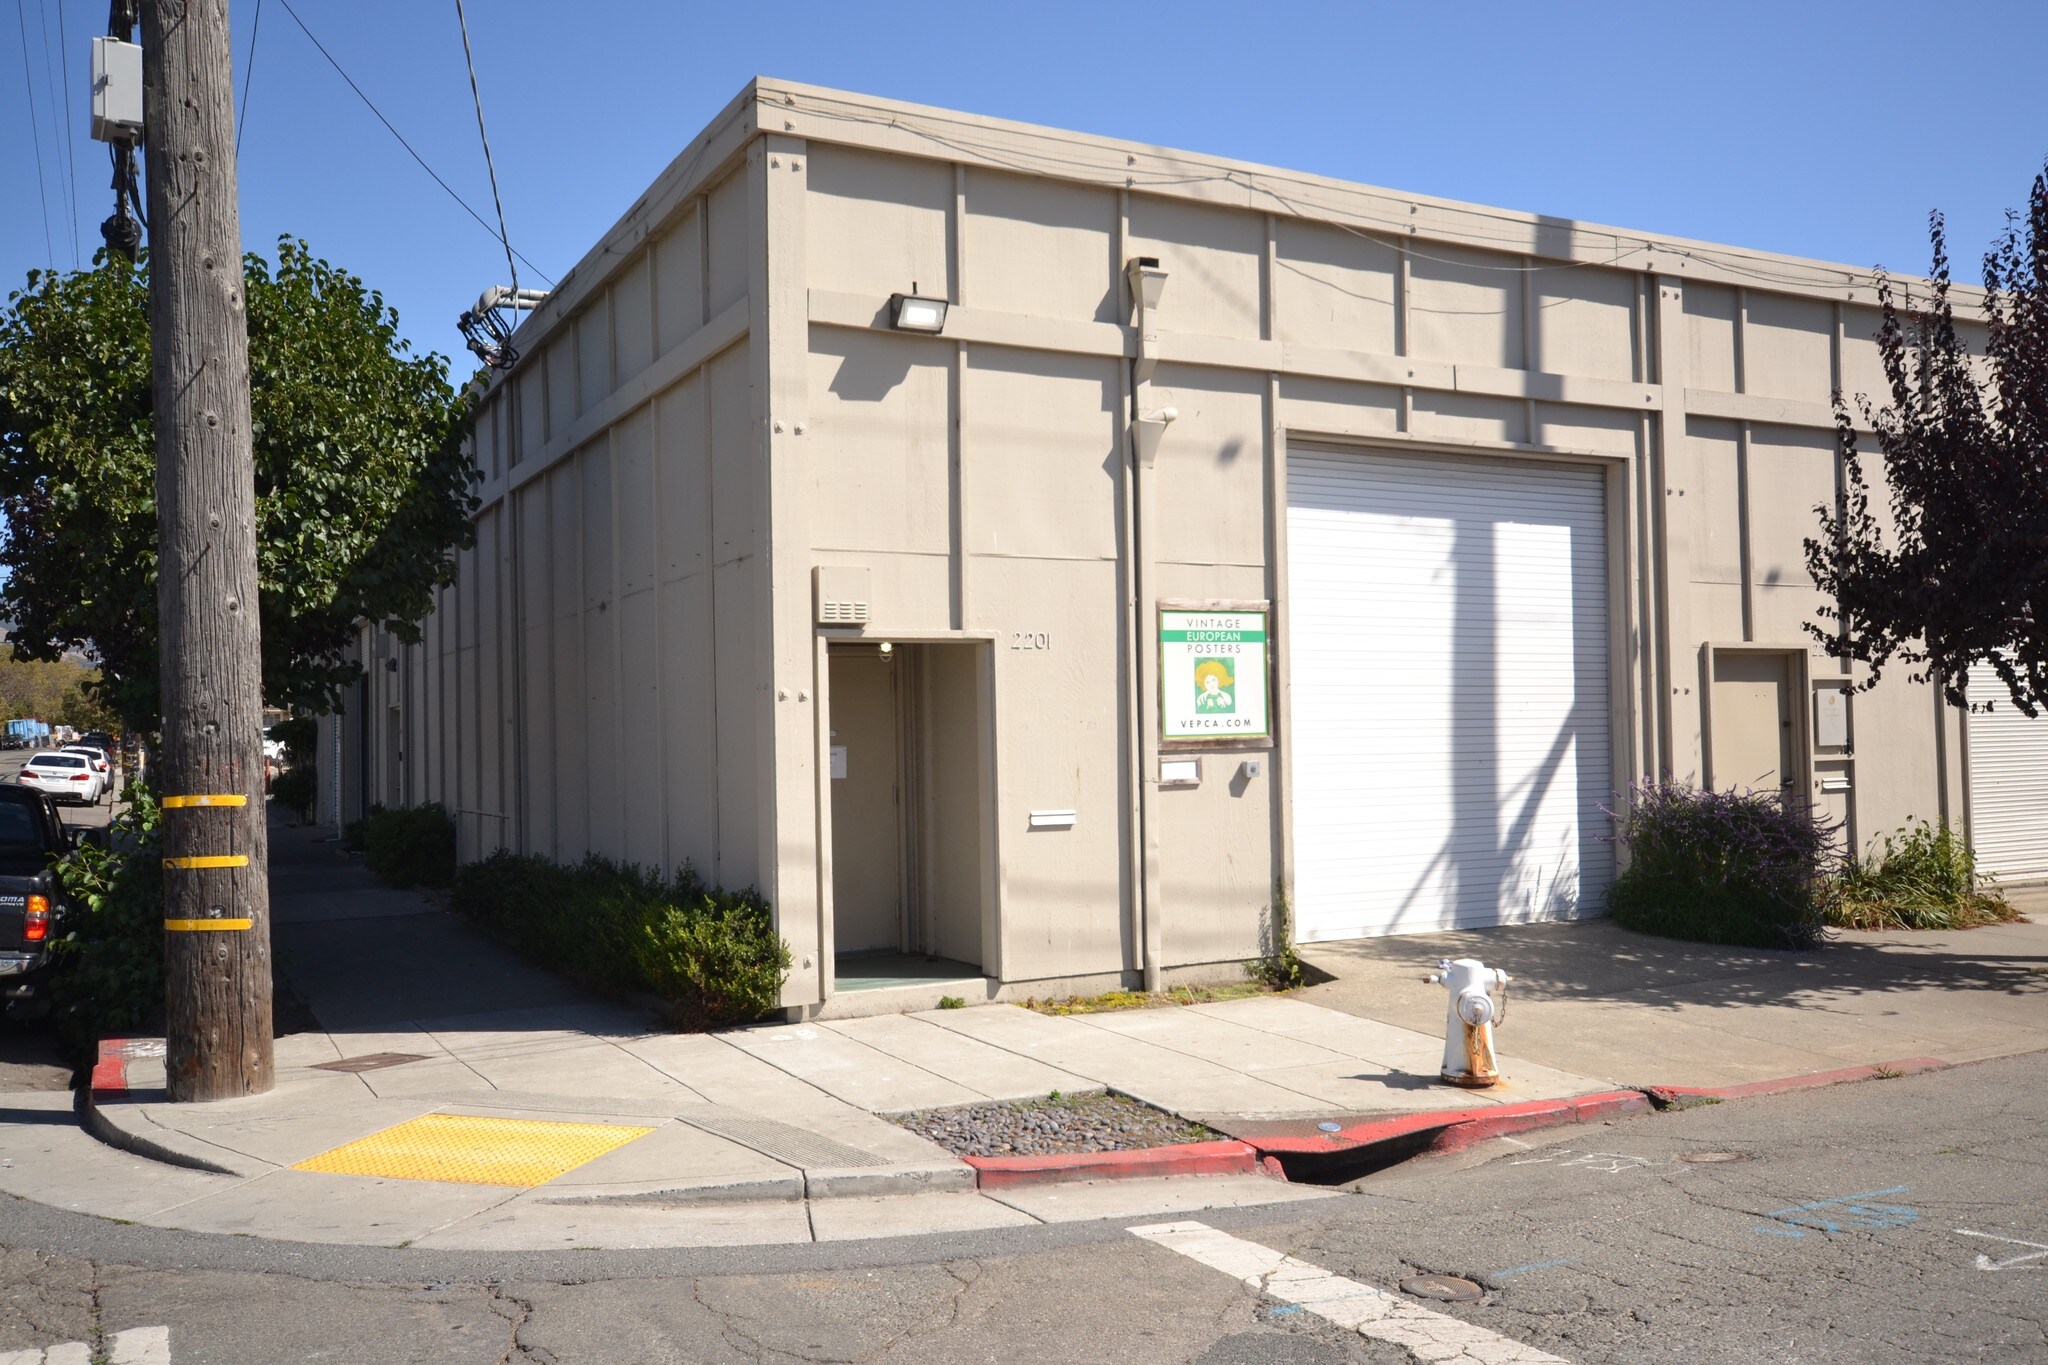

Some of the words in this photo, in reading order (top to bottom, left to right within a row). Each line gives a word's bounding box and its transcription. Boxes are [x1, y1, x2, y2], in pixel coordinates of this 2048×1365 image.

[1186, 618, 1241, 629] VINTAGE
[1010, 631, 1051, 650] 2201
[1186, 631, 1241, 641] EUROPEAN
[1187, 643, 1241, 654] POSTERS
[1180, 718, 1252, 728] VEPCA.COM
